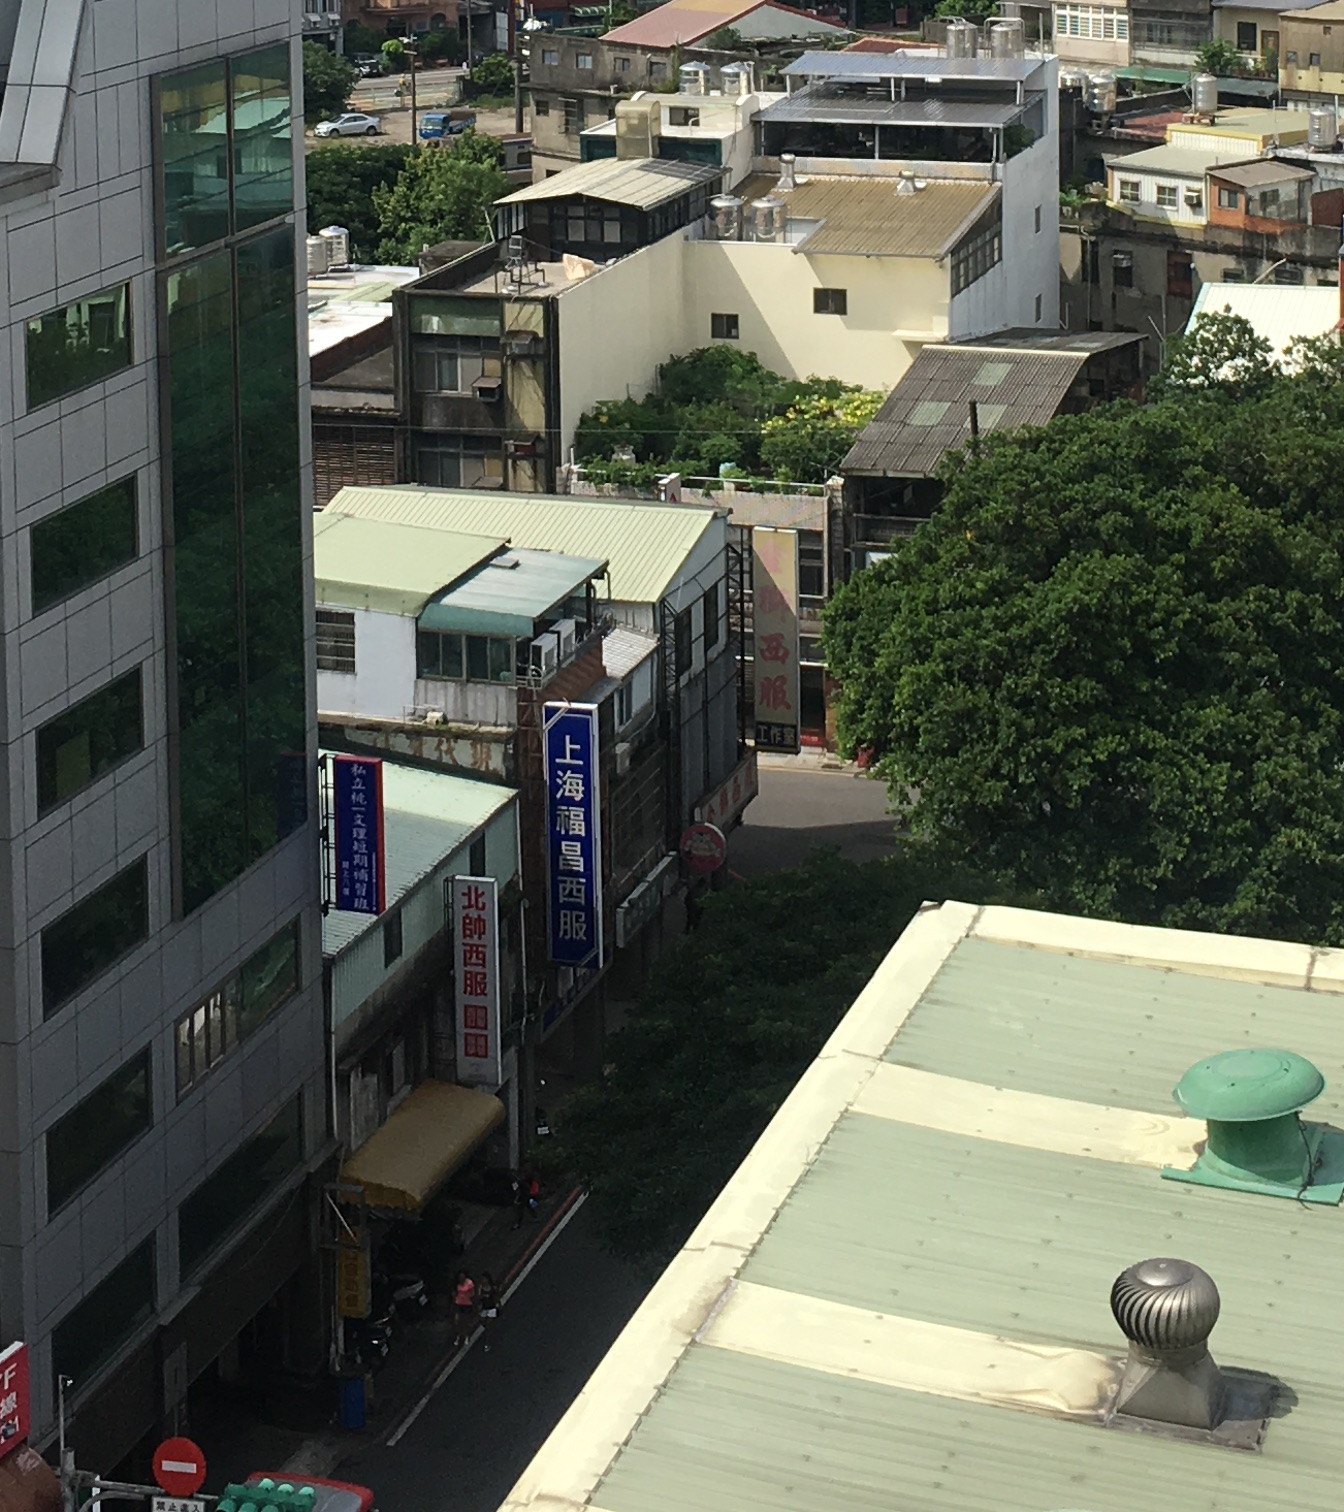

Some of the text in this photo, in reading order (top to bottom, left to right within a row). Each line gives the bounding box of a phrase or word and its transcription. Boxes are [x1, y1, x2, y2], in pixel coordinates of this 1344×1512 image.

[553, 735, 588, 943] 上海福昌西服
[461, 884, 488, 998] 北帥西服
